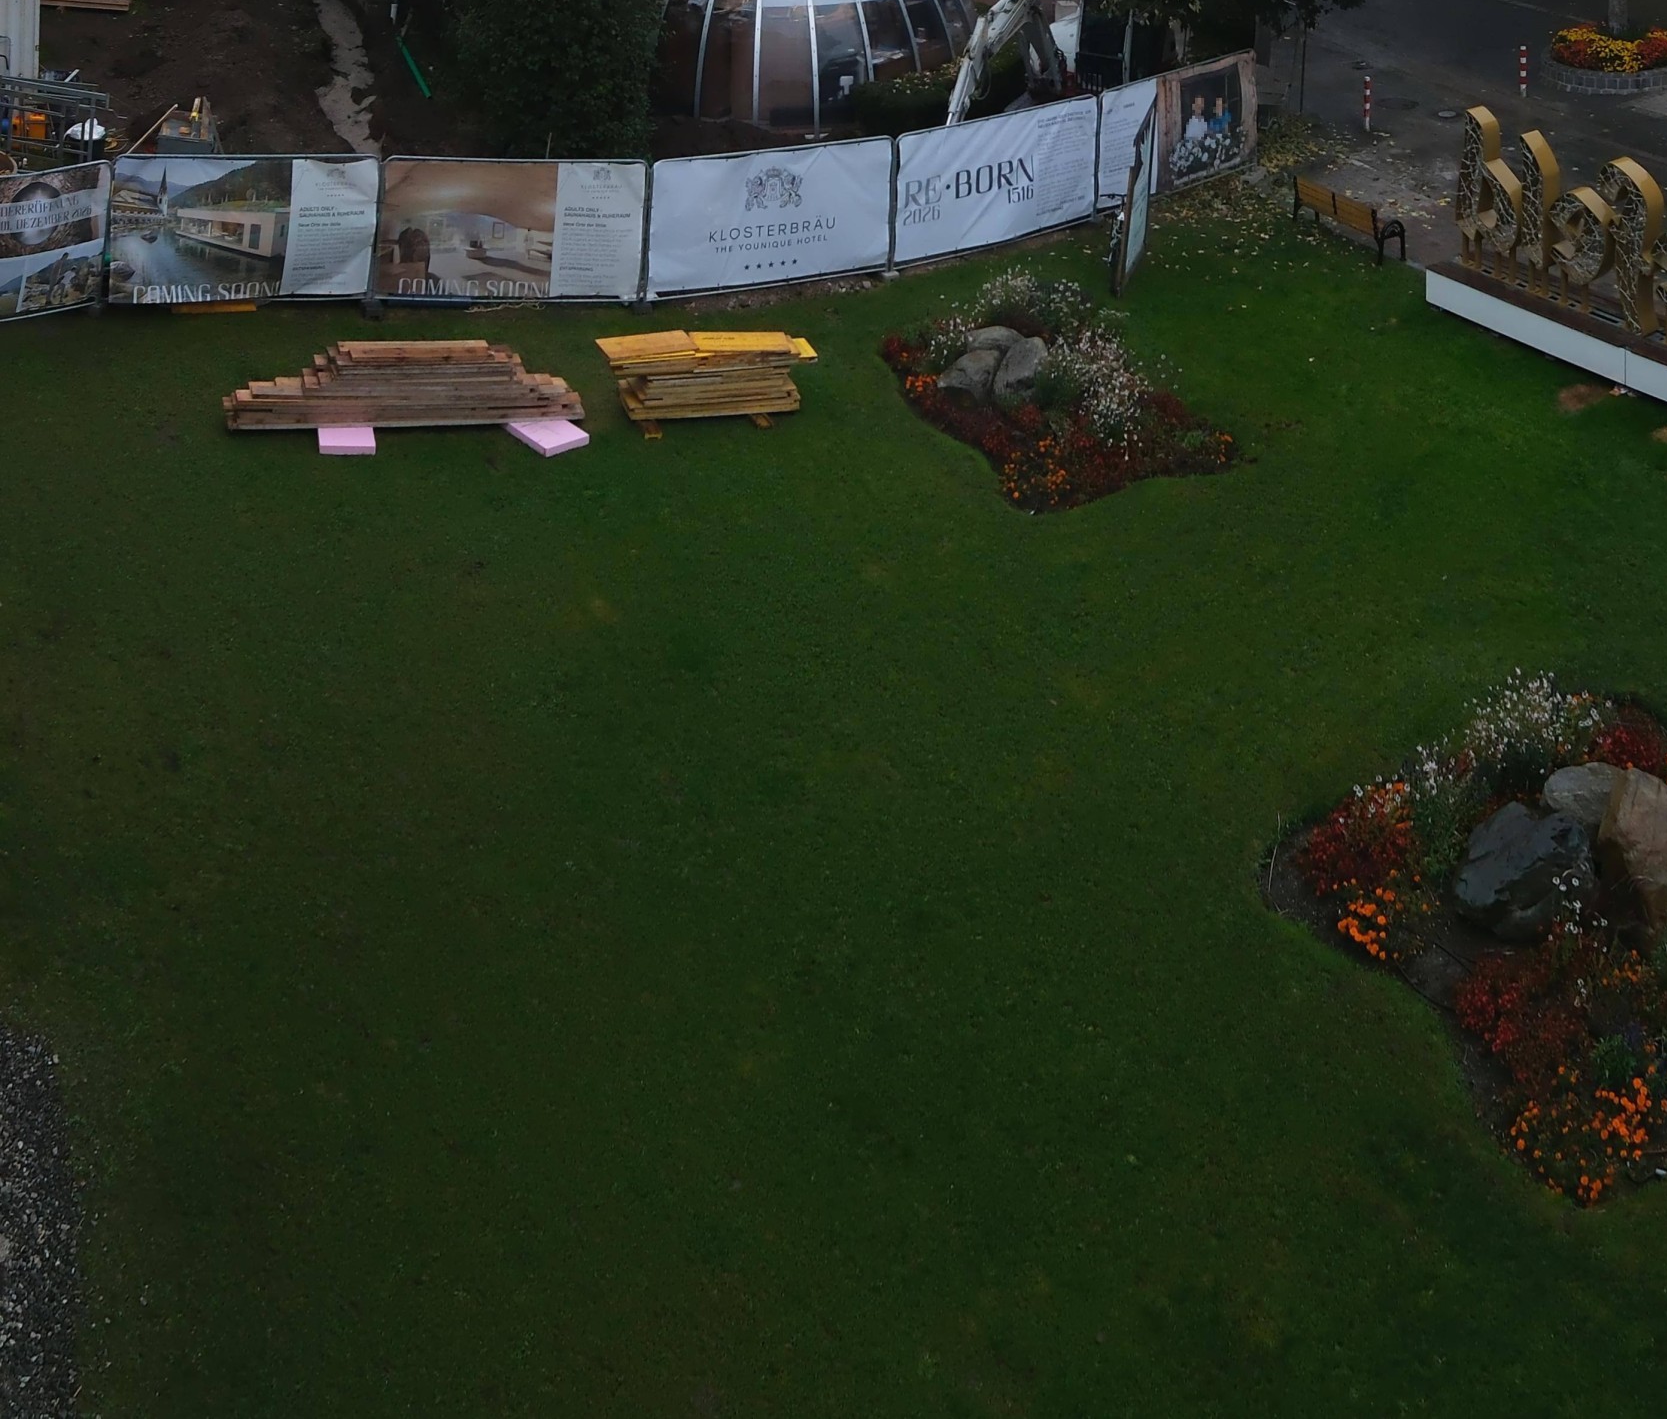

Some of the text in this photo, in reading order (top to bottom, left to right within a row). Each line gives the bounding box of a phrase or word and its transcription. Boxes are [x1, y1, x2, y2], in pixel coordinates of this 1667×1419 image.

[1007, 185, 1034, 205] 1516
[708, 215, 837, 243] KLOSTERBRÄU
[715, 234, 829, 254] THE YOUNIQUE HOTEL
